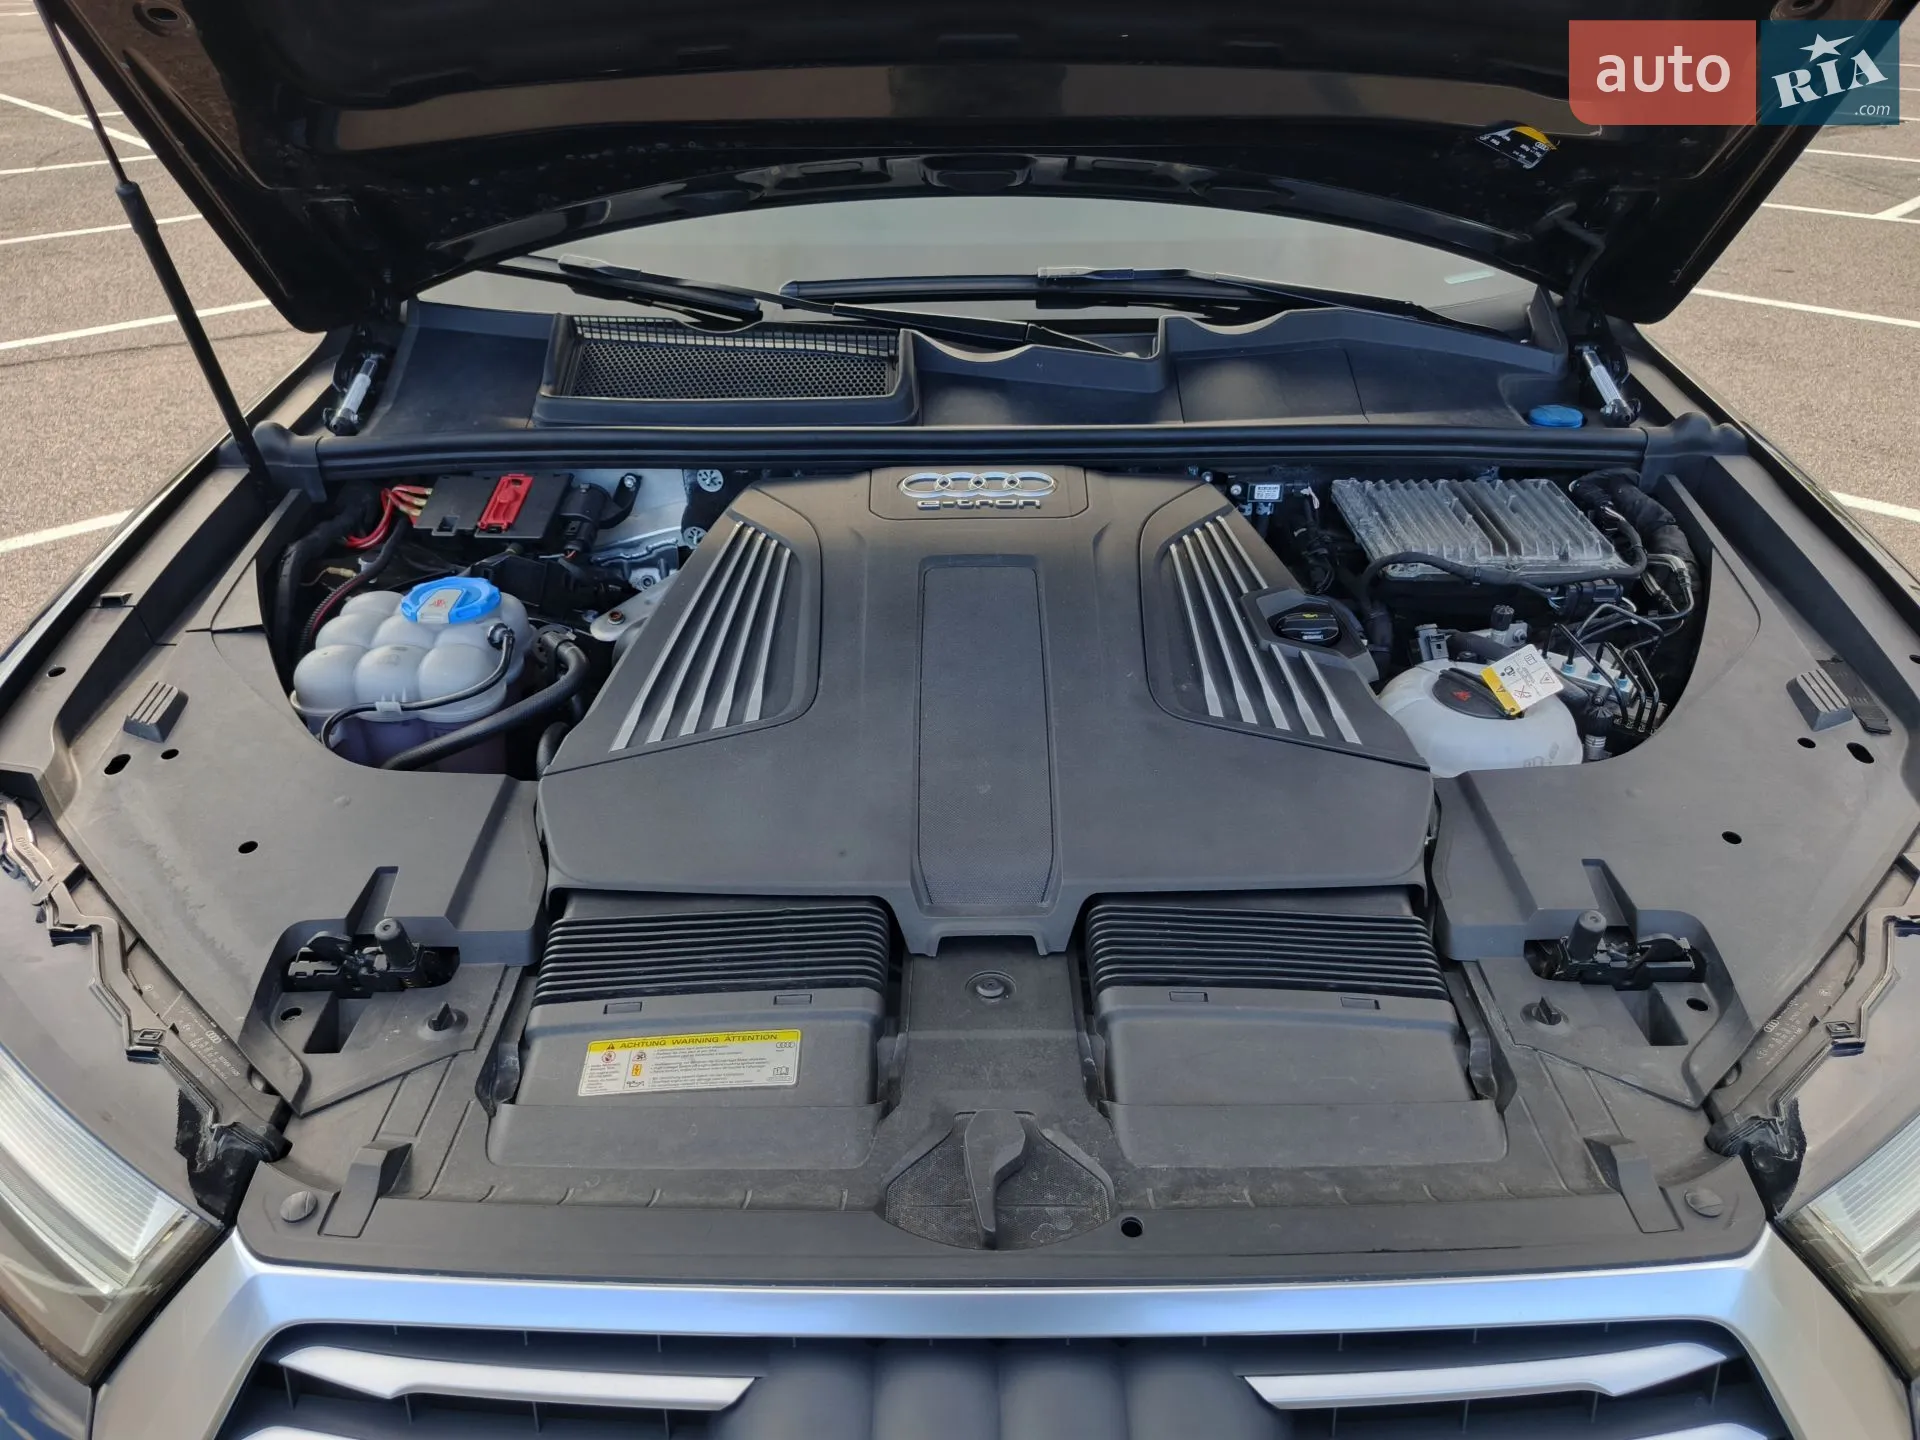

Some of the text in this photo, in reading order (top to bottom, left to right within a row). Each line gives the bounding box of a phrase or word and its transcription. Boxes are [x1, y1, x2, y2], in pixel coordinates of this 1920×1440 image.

[917, 499, 1041, 510] e-tron
[619, 1034, 778, 1049] ACHTUNG WARNING ATTENTION
